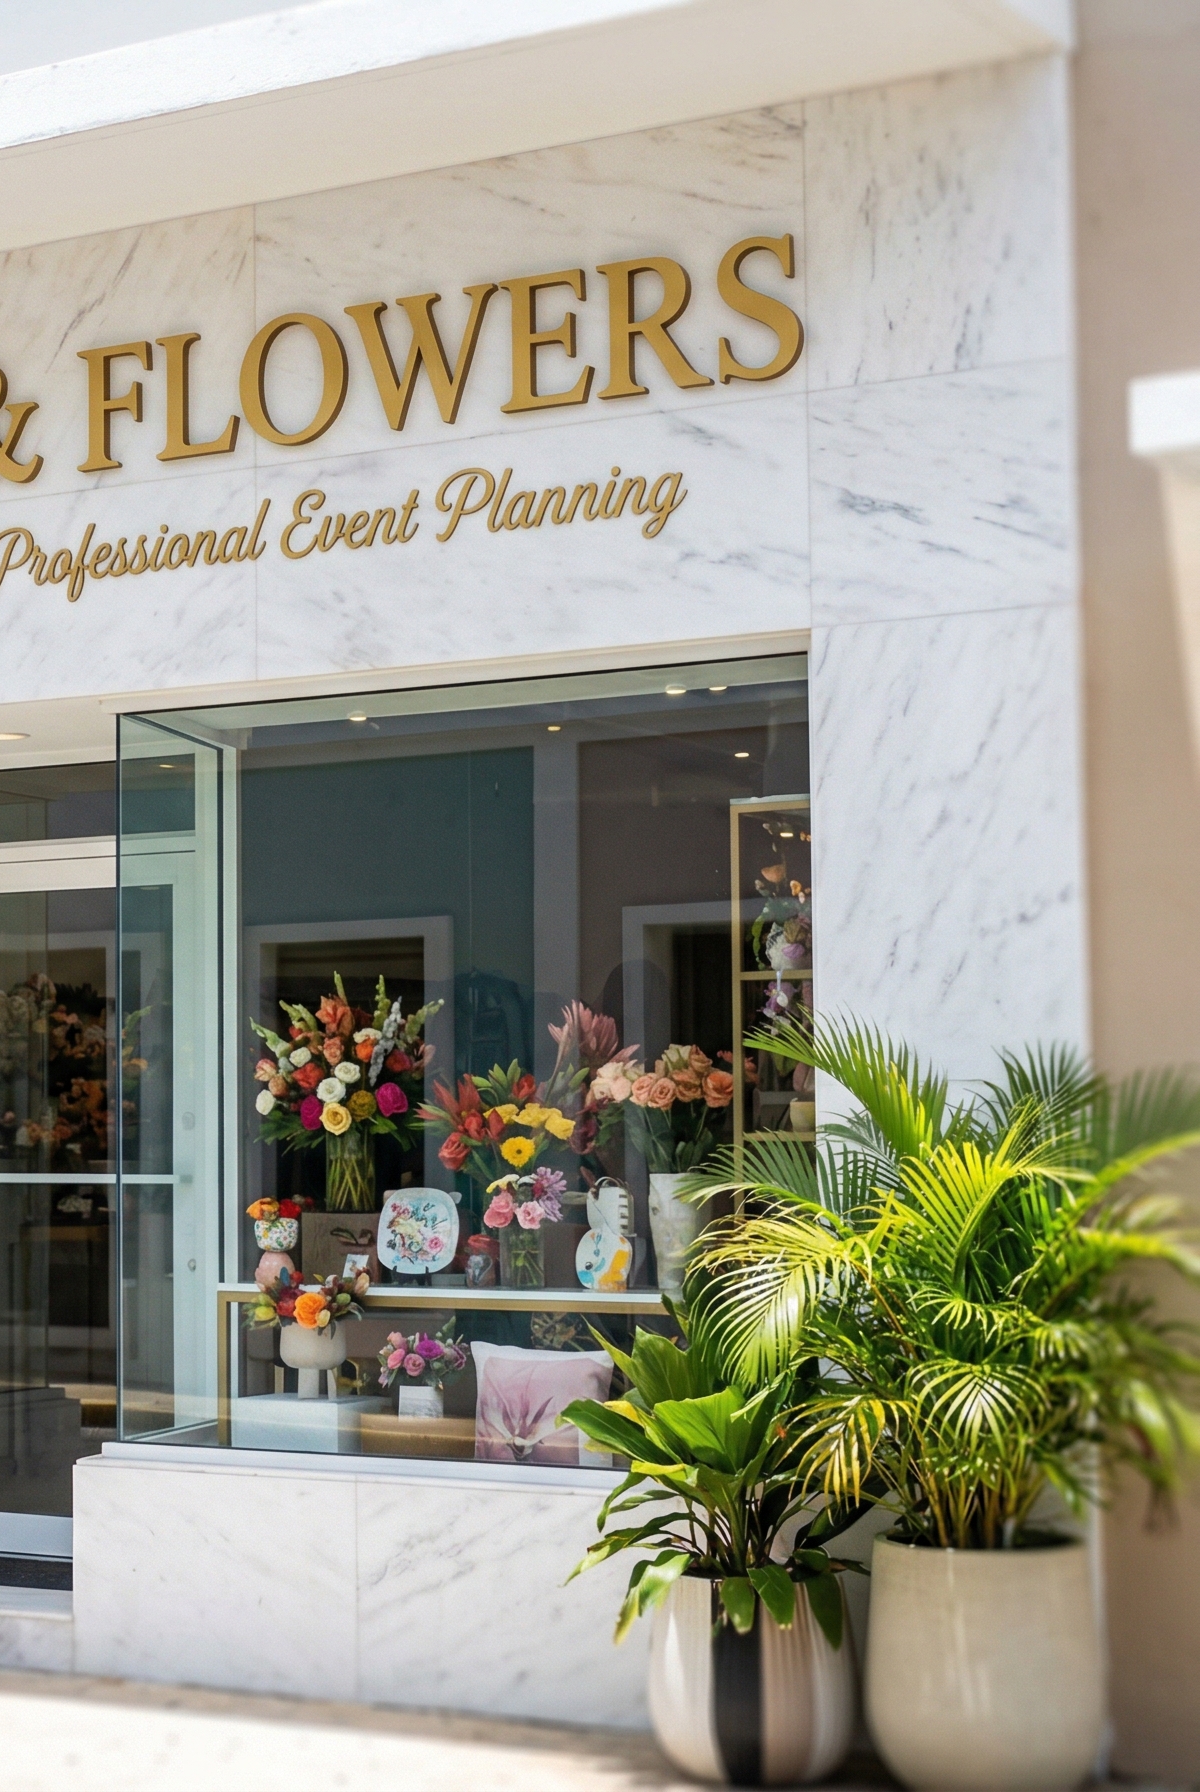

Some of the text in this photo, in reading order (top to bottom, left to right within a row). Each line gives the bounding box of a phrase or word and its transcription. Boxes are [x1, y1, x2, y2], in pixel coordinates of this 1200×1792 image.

[77, 233, 805, 472] FLOWERS
[280, 489, 420, 560] Event
[434, 465, 686, 542] Planning
